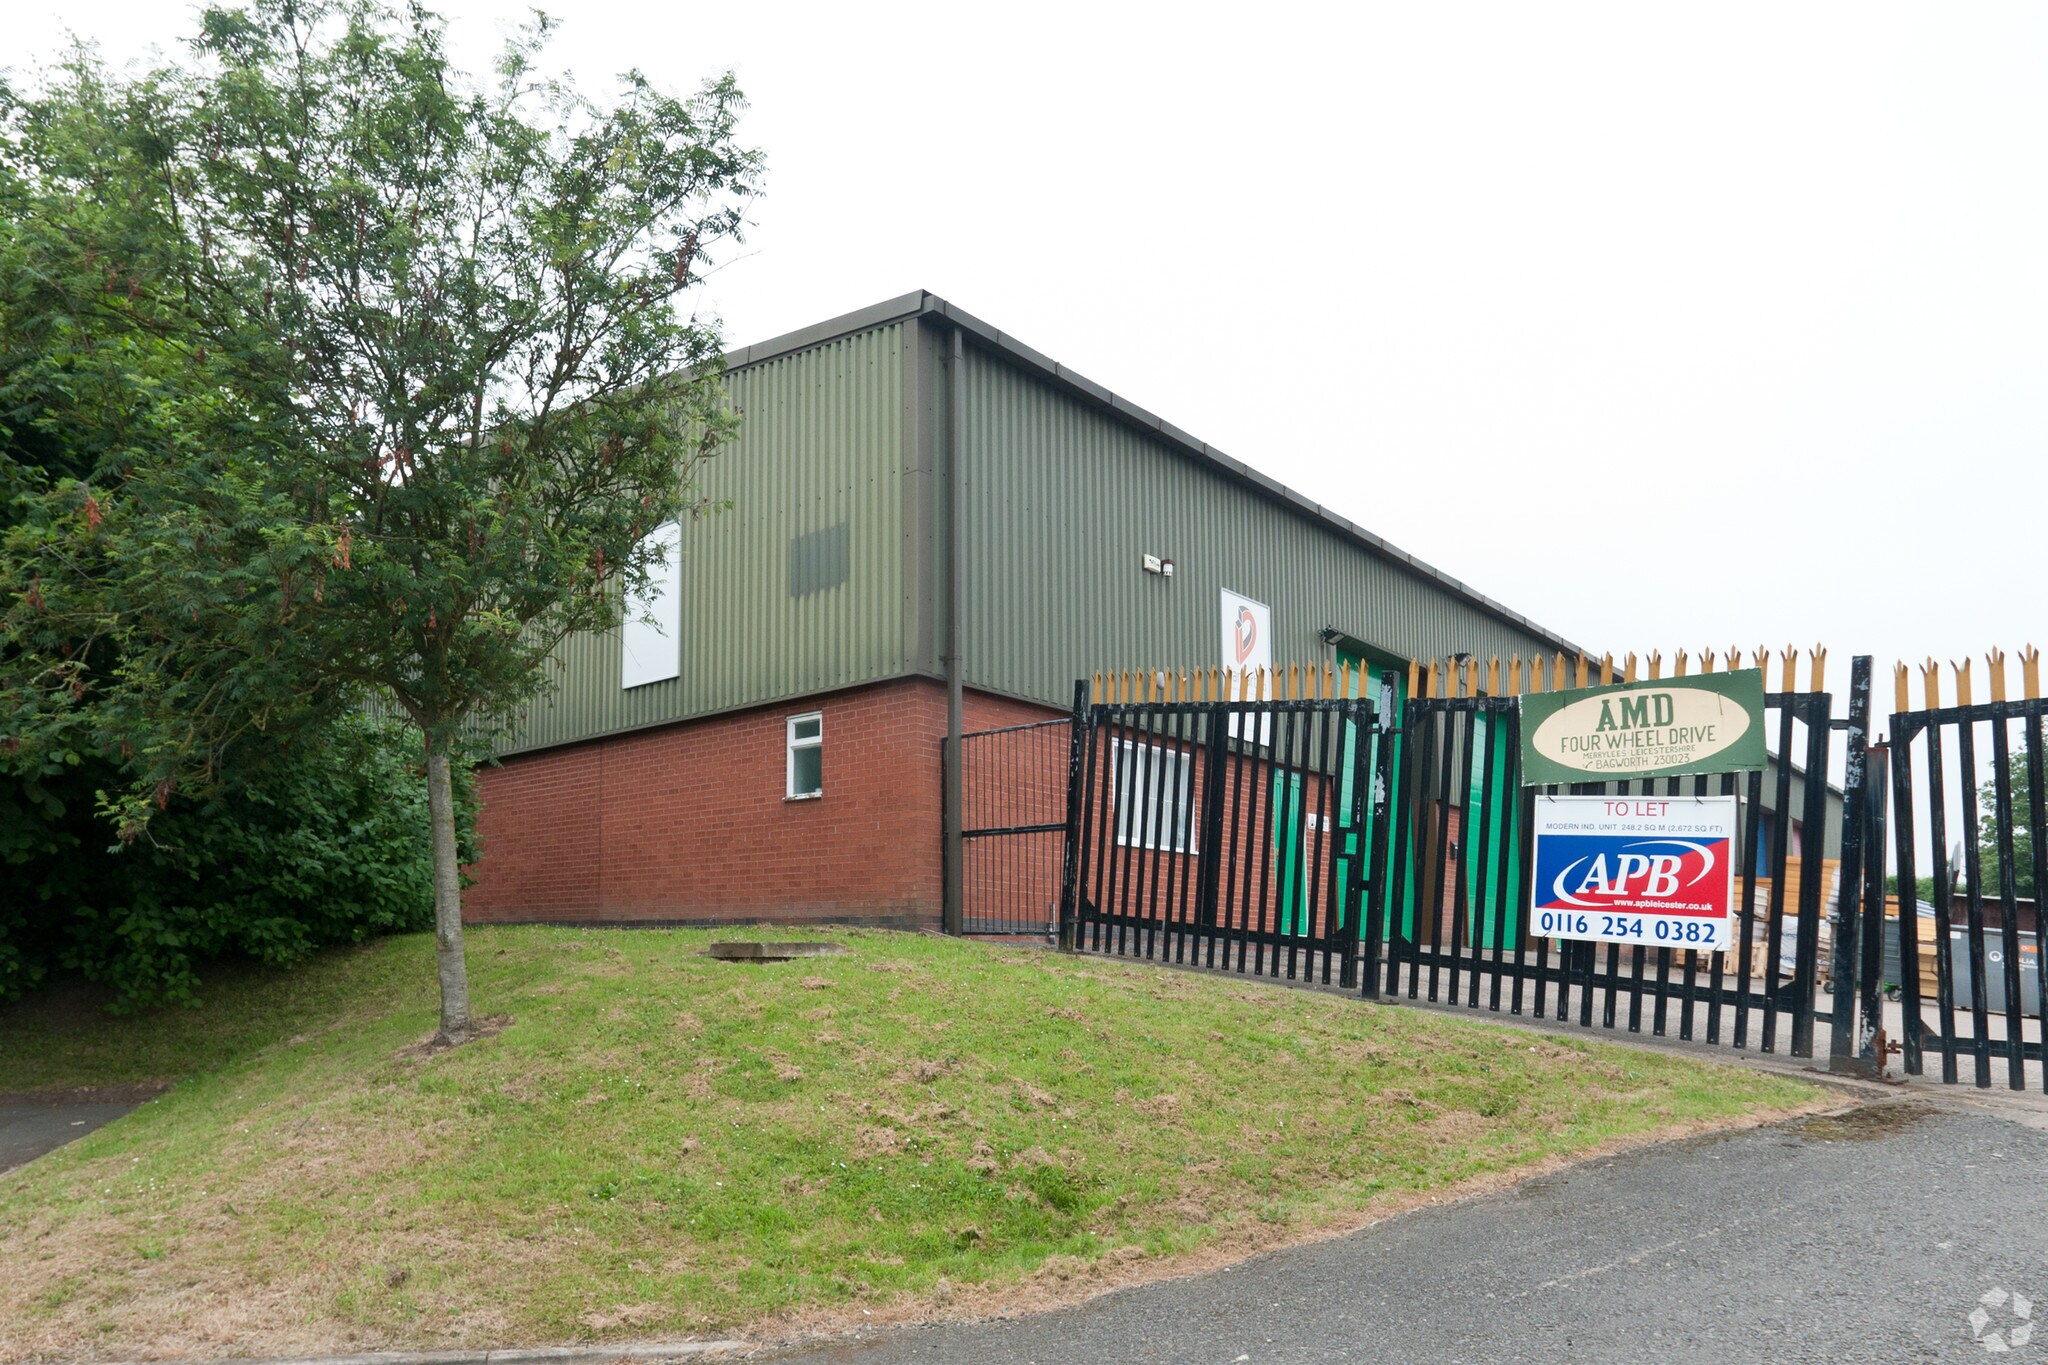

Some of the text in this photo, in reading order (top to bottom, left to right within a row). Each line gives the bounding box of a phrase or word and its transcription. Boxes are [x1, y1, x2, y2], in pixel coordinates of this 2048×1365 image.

[1596, 693, 1674, 732] AMD
[1561, 725, 1716, 753] FOUR WHEEL DRIVE
[1596, 753, 1690, 769] BAGWORTH 230023
[1604, 801, 1670, 817] TO LET
[1581, 823, 1597, 831] IND.
[1599, 823, 1618, 831] UNIT
[1644, 824, 1656, 832] SQ
[1658, 824, 1666, 832] M
[1694, 825, 1707, 833] SQ
[1709, 825, 1723, 833] FT)
[1575, 852, 1682, 897] APB
[1613, 899, 1713, 911] www.apbleicester.co.uk
[1541, 912, 1715, 943] 0116 254 0382
